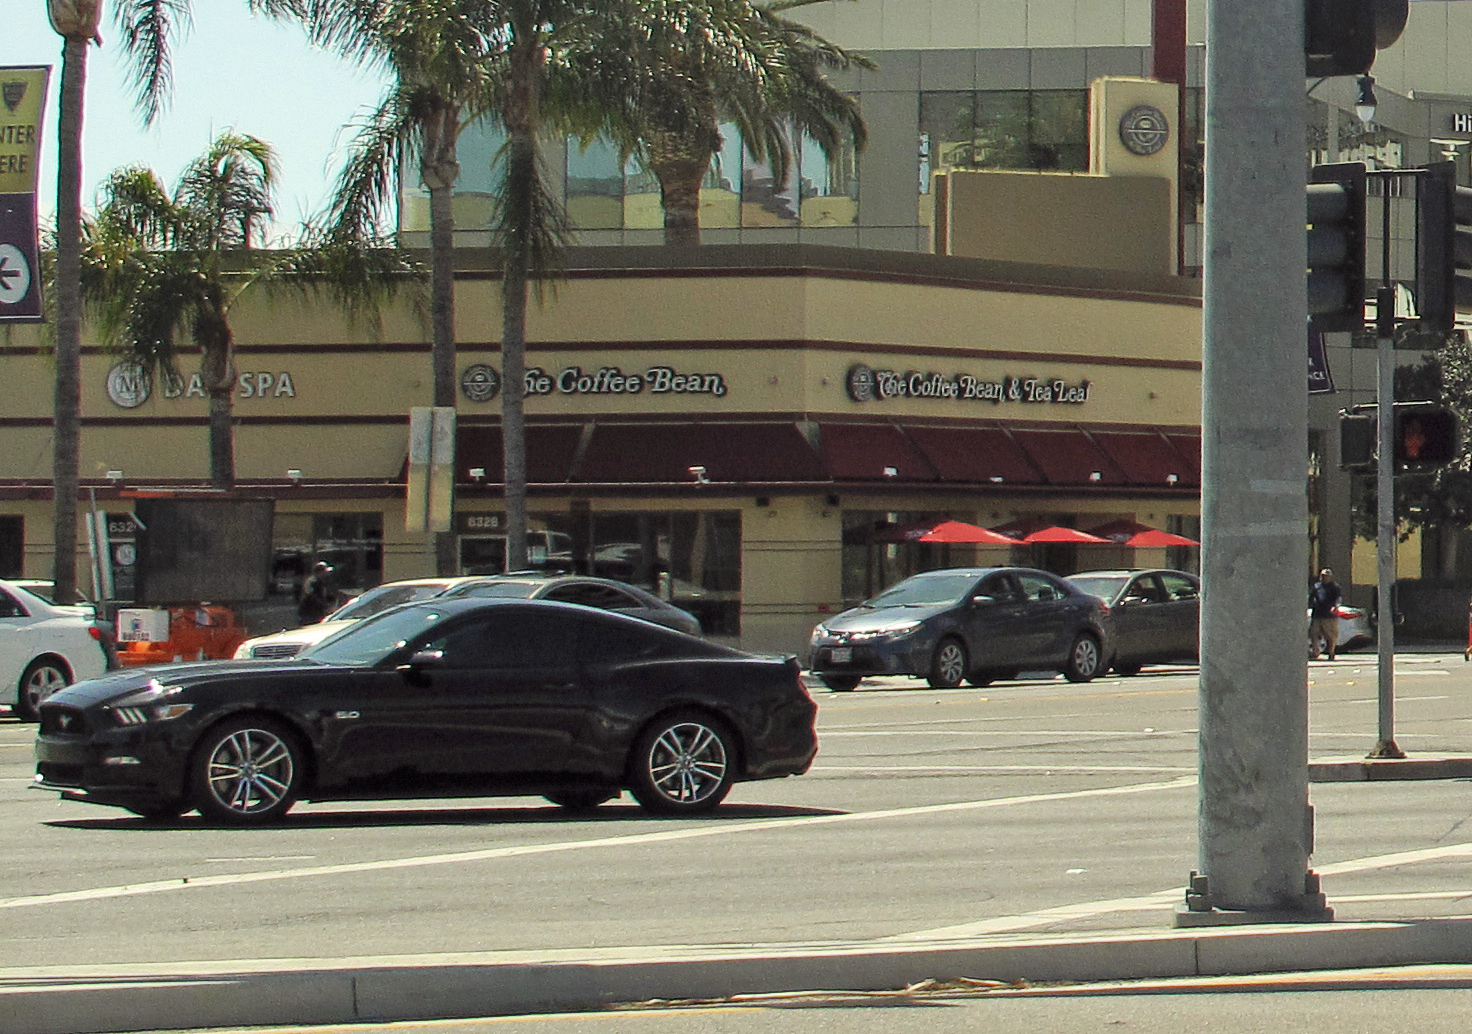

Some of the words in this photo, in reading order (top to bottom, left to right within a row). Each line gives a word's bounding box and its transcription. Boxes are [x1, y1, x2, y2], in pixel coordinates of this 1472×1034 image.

[0, 154, 28, 174] ERE
[165, 372, 208, 398] DA
[239, 371, 297, 398] SPA
[524, 367, 551, 394] he
[556, 366, 642, 394] Coffee
[644, 367, 726, 396] Bean
[878, 371, 908, 398] The
[909, 372, 959, 398] Coffee
[959, 374, 1006, 403] Bean
[1008, 376, 1022, 401] &
[1024, 378, 1052, 403] Tea
[1053, 379, 1094, 403] Leaf
